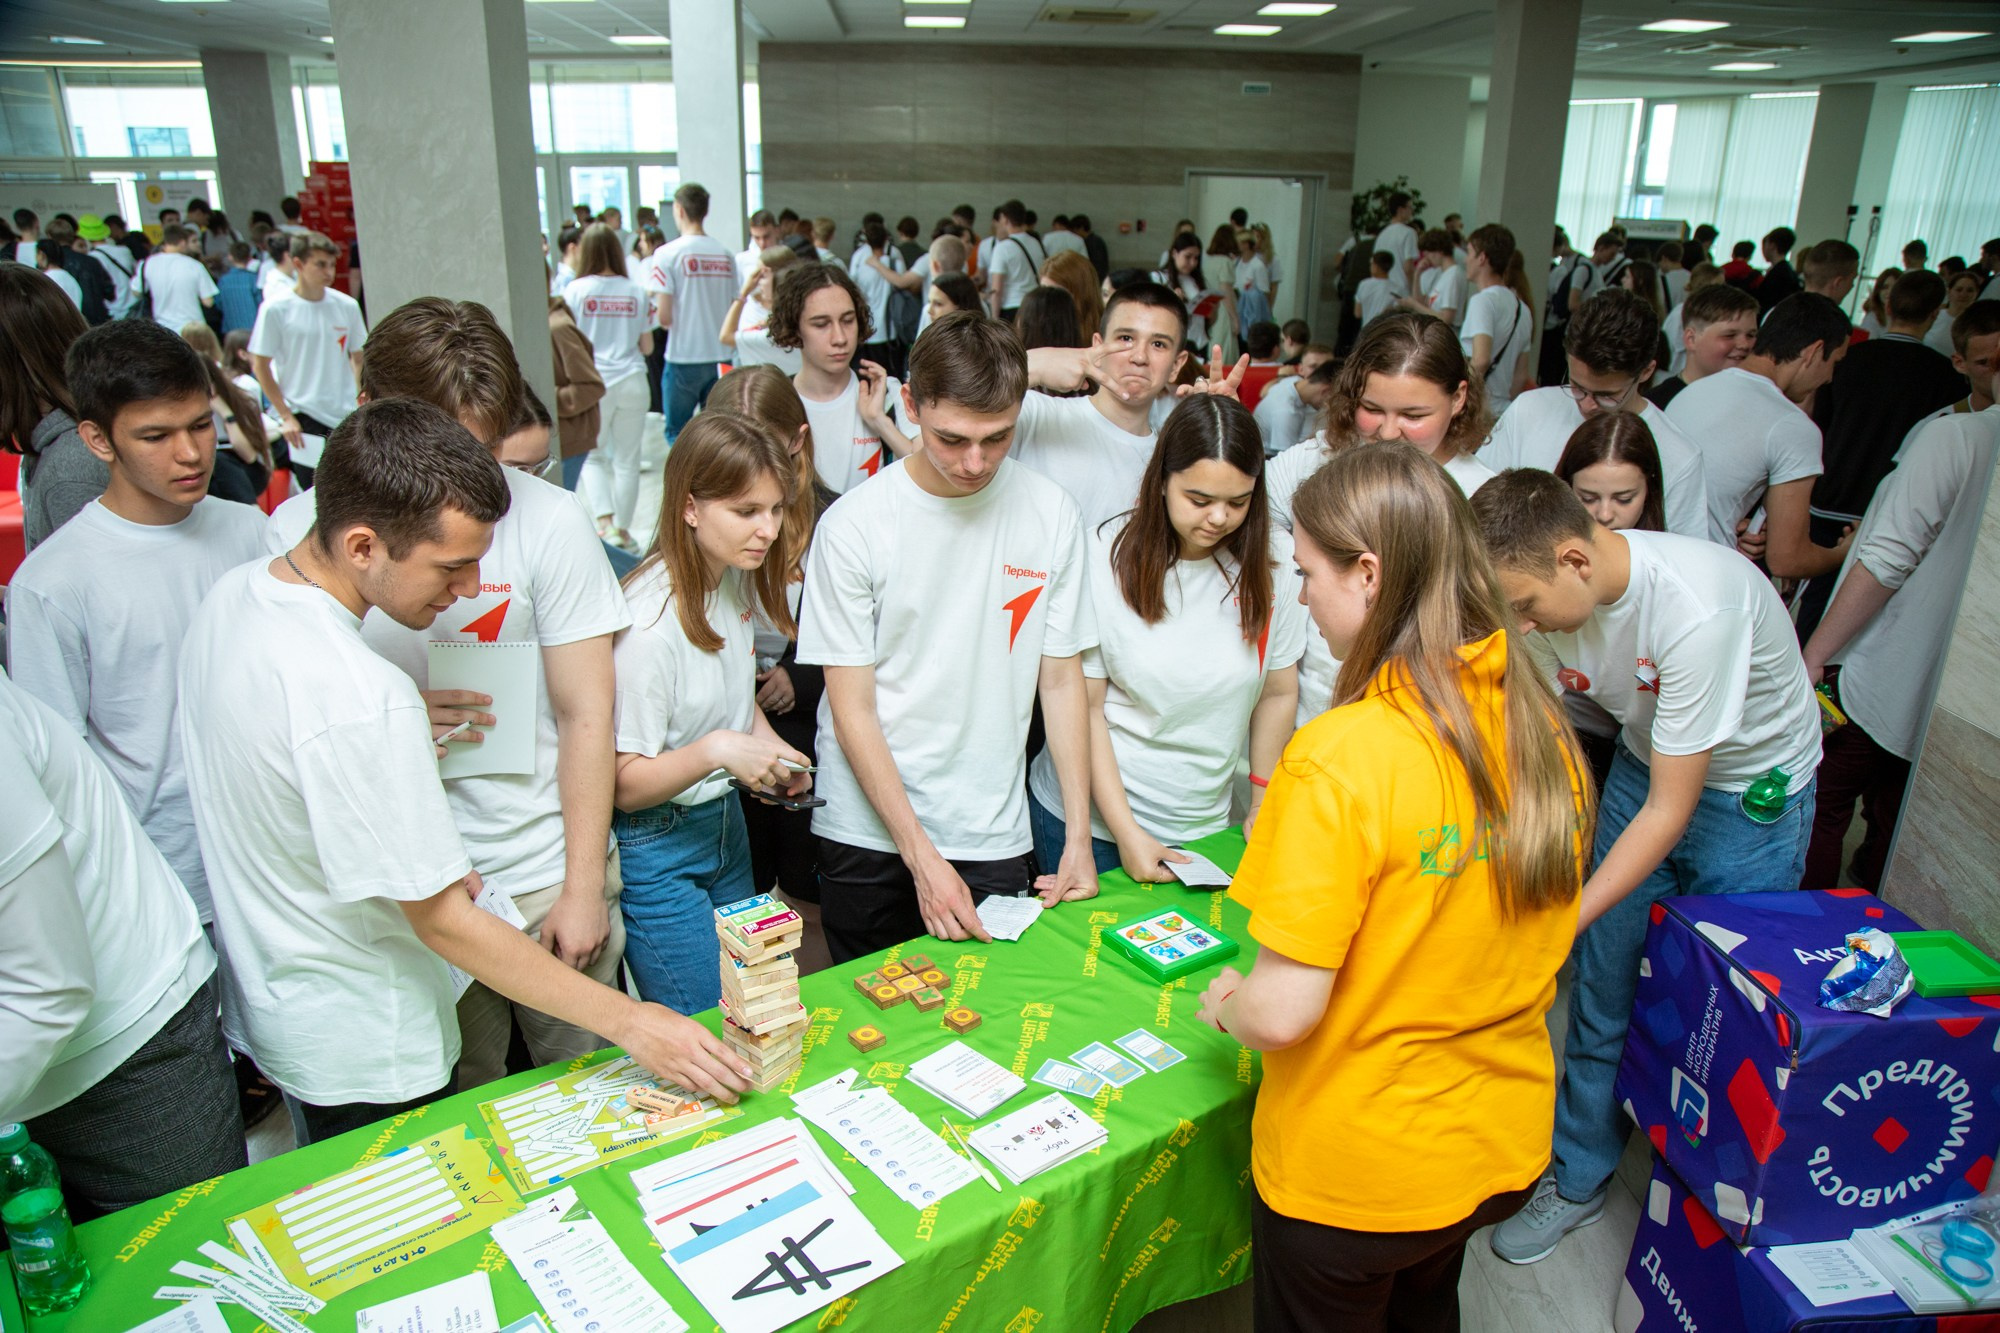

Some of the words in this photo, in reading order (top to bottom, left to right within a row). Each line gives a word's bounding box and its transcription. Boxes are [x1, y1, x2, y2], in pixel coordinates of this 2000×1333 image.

[1003, 564, 1047, 580] Первые
[480, 583, 512, 593] вые
[967, 971, 983, 990] БАНК
[815, 1024, 835, 1046] БАНК
[1035, 1021, 1050, 1042] БАНК
[1693, 984, 1719, 1078] МОЛОДЕЖНЫХ
[1684, 1031, 1698, 1069] ЦЕНТР
[1700, 1008, 1723, 1085] ИНИЦИАТИВ
[1807, 1059, 1974, 1208] Предприимчивость
[603, 1143, 625, 1154] пару
[1041, 1138, 1070, 1153] Ребус
[438, 1150, 447, 1159] 5
[445, 1162, 455, 1170] 4
[1149, 1153, 1178, 1186] БАНК
[453, 1172, 464, 1180] 3
[459, 1182, 471, 1191] 2
[468, 1195, 479, 1204] 1
[1100, 1149, 1173, 1262] ЦЕНТР-ИНВЕСТ
[399, 1253, 410, 1263] А
[411, 1245, 427, 1257] От
[992, 1236, 1024, 1273] БАНК
[372, 1264, 382, 1274] Я
[384, 1258, 398, 1268] до
[1134, 1246, 1160, 1279] БАНК
